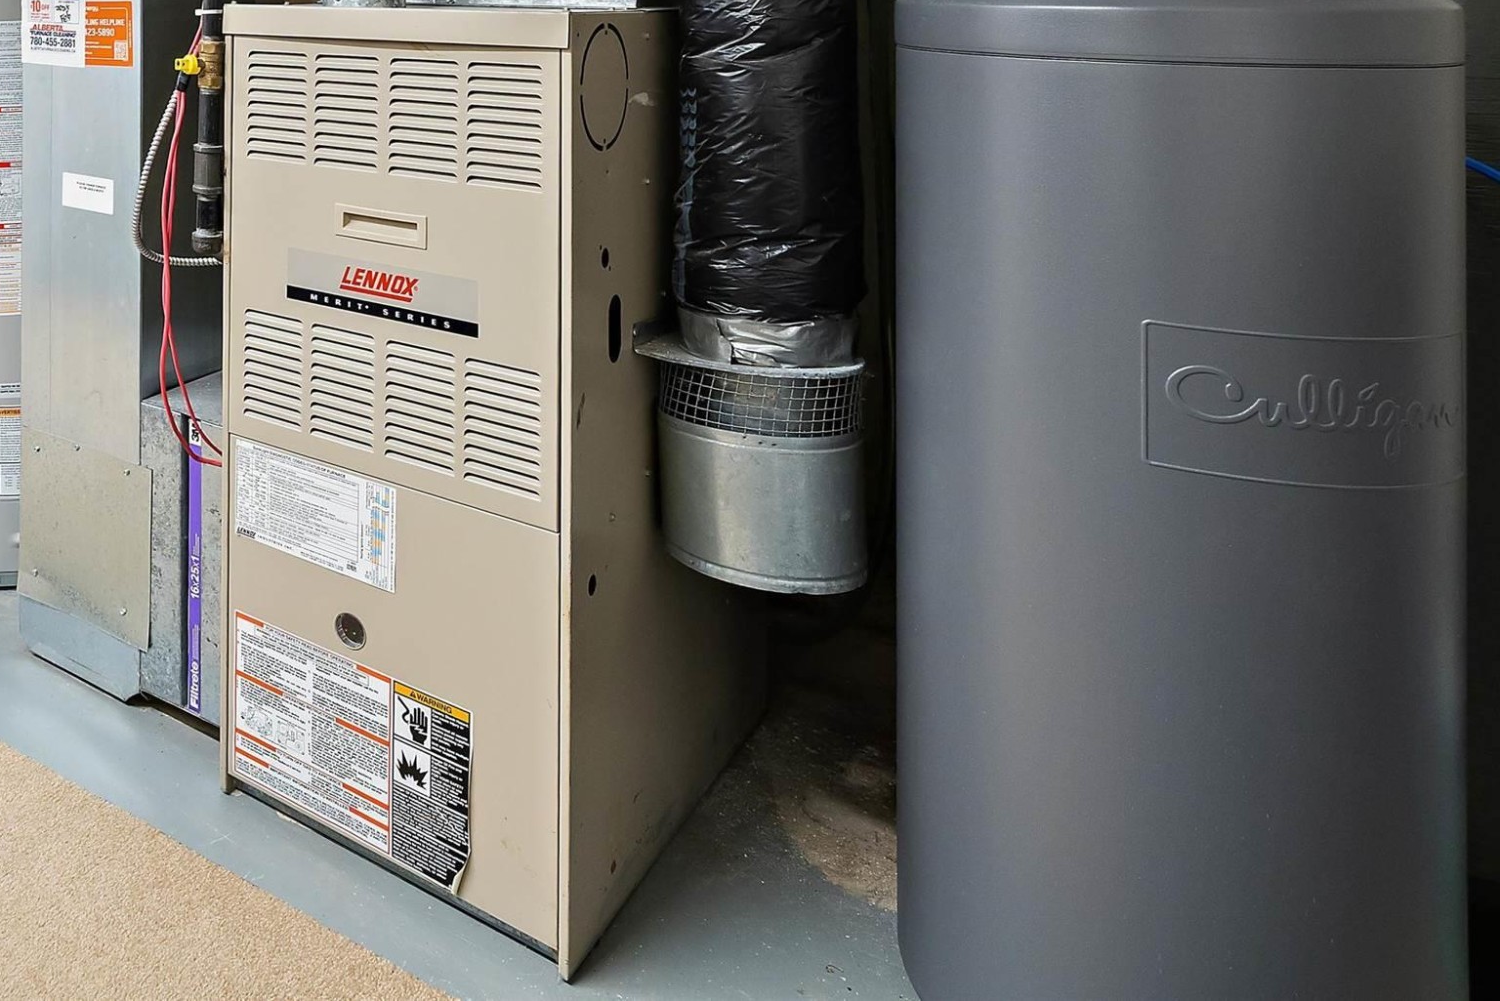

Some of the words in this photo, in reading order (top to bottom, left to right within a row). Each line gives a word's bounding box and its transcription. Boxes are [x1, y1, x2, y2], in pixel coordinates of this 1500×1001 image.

[31, 23, 64, 32] ALBERTA
[30, 37, 76, 48] 780-455-2881
[341, 266, 419, 297] LENNOX
[383, 308, 451, 329] SERIES
[1165, 364, 1459, 461] Culligan
[237, 527, 256, 538] LENNOX
[190, 555, 199, 598] 16x25x1
[190, 661, 199, 709] Filtrete
[417, 693, 453, 714] WARNING
